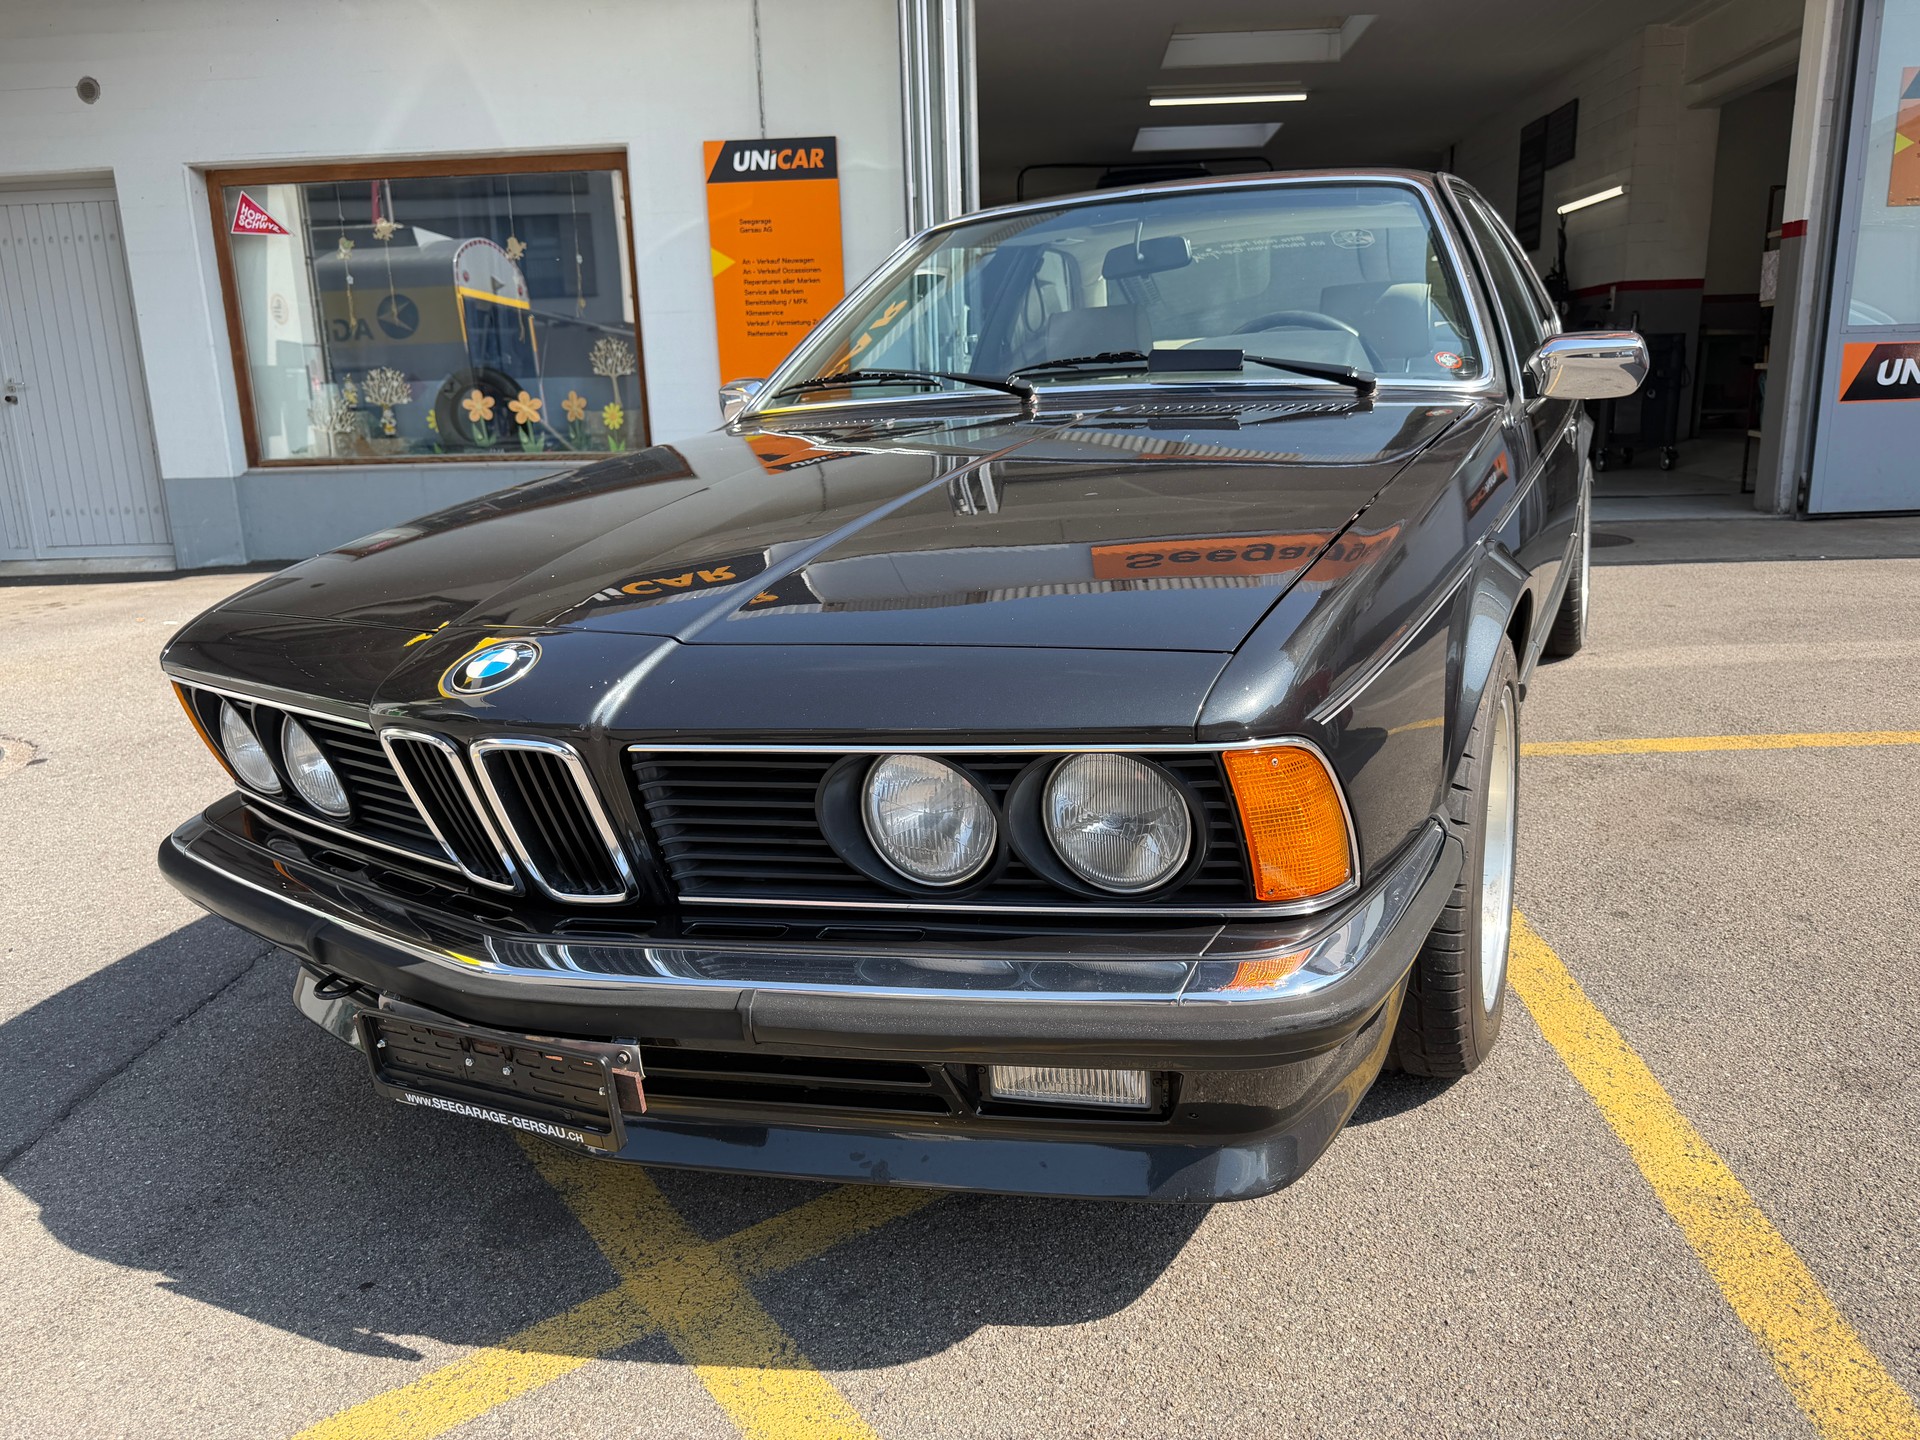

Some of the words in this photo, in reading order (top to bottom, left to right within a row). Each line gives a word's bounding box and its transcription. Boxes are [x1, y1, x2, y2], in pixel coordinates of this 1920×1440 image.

[240, 202, 269, 221] HOPP
[739, 218, 772, 226] Seegarage
[781, 257, 815, 266] Neuwagen
[744, 279, 781, 287] Reparaturen
[745, 299, 787, 307] Bereitstellung
[776, 319, 812, 328] Vermietung
